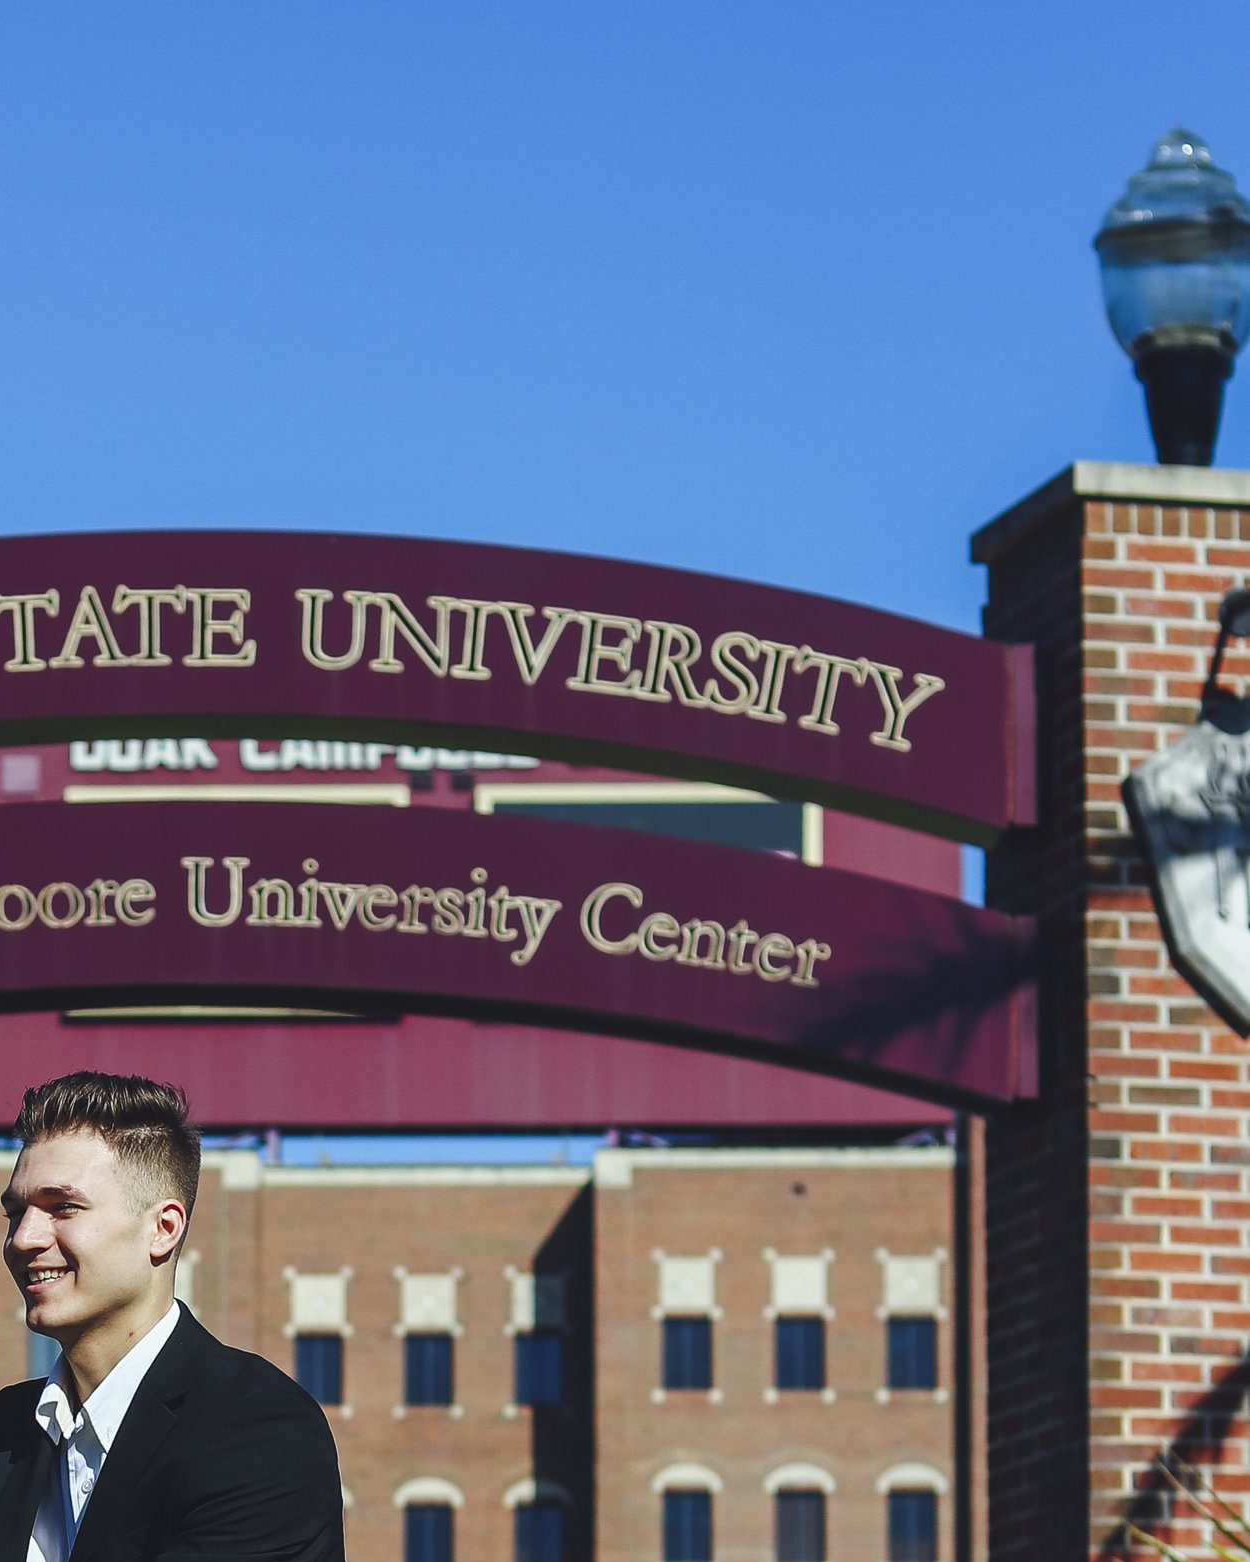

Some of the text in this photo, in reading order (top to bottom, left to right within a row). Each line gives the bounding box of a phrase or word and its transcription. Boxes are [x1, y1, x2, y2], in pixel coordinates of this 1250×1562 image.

[295, 589, 945, 752] UNIVERSITY
[181, 856, 562, 966] University
[580, 883, 831, 986] Center
